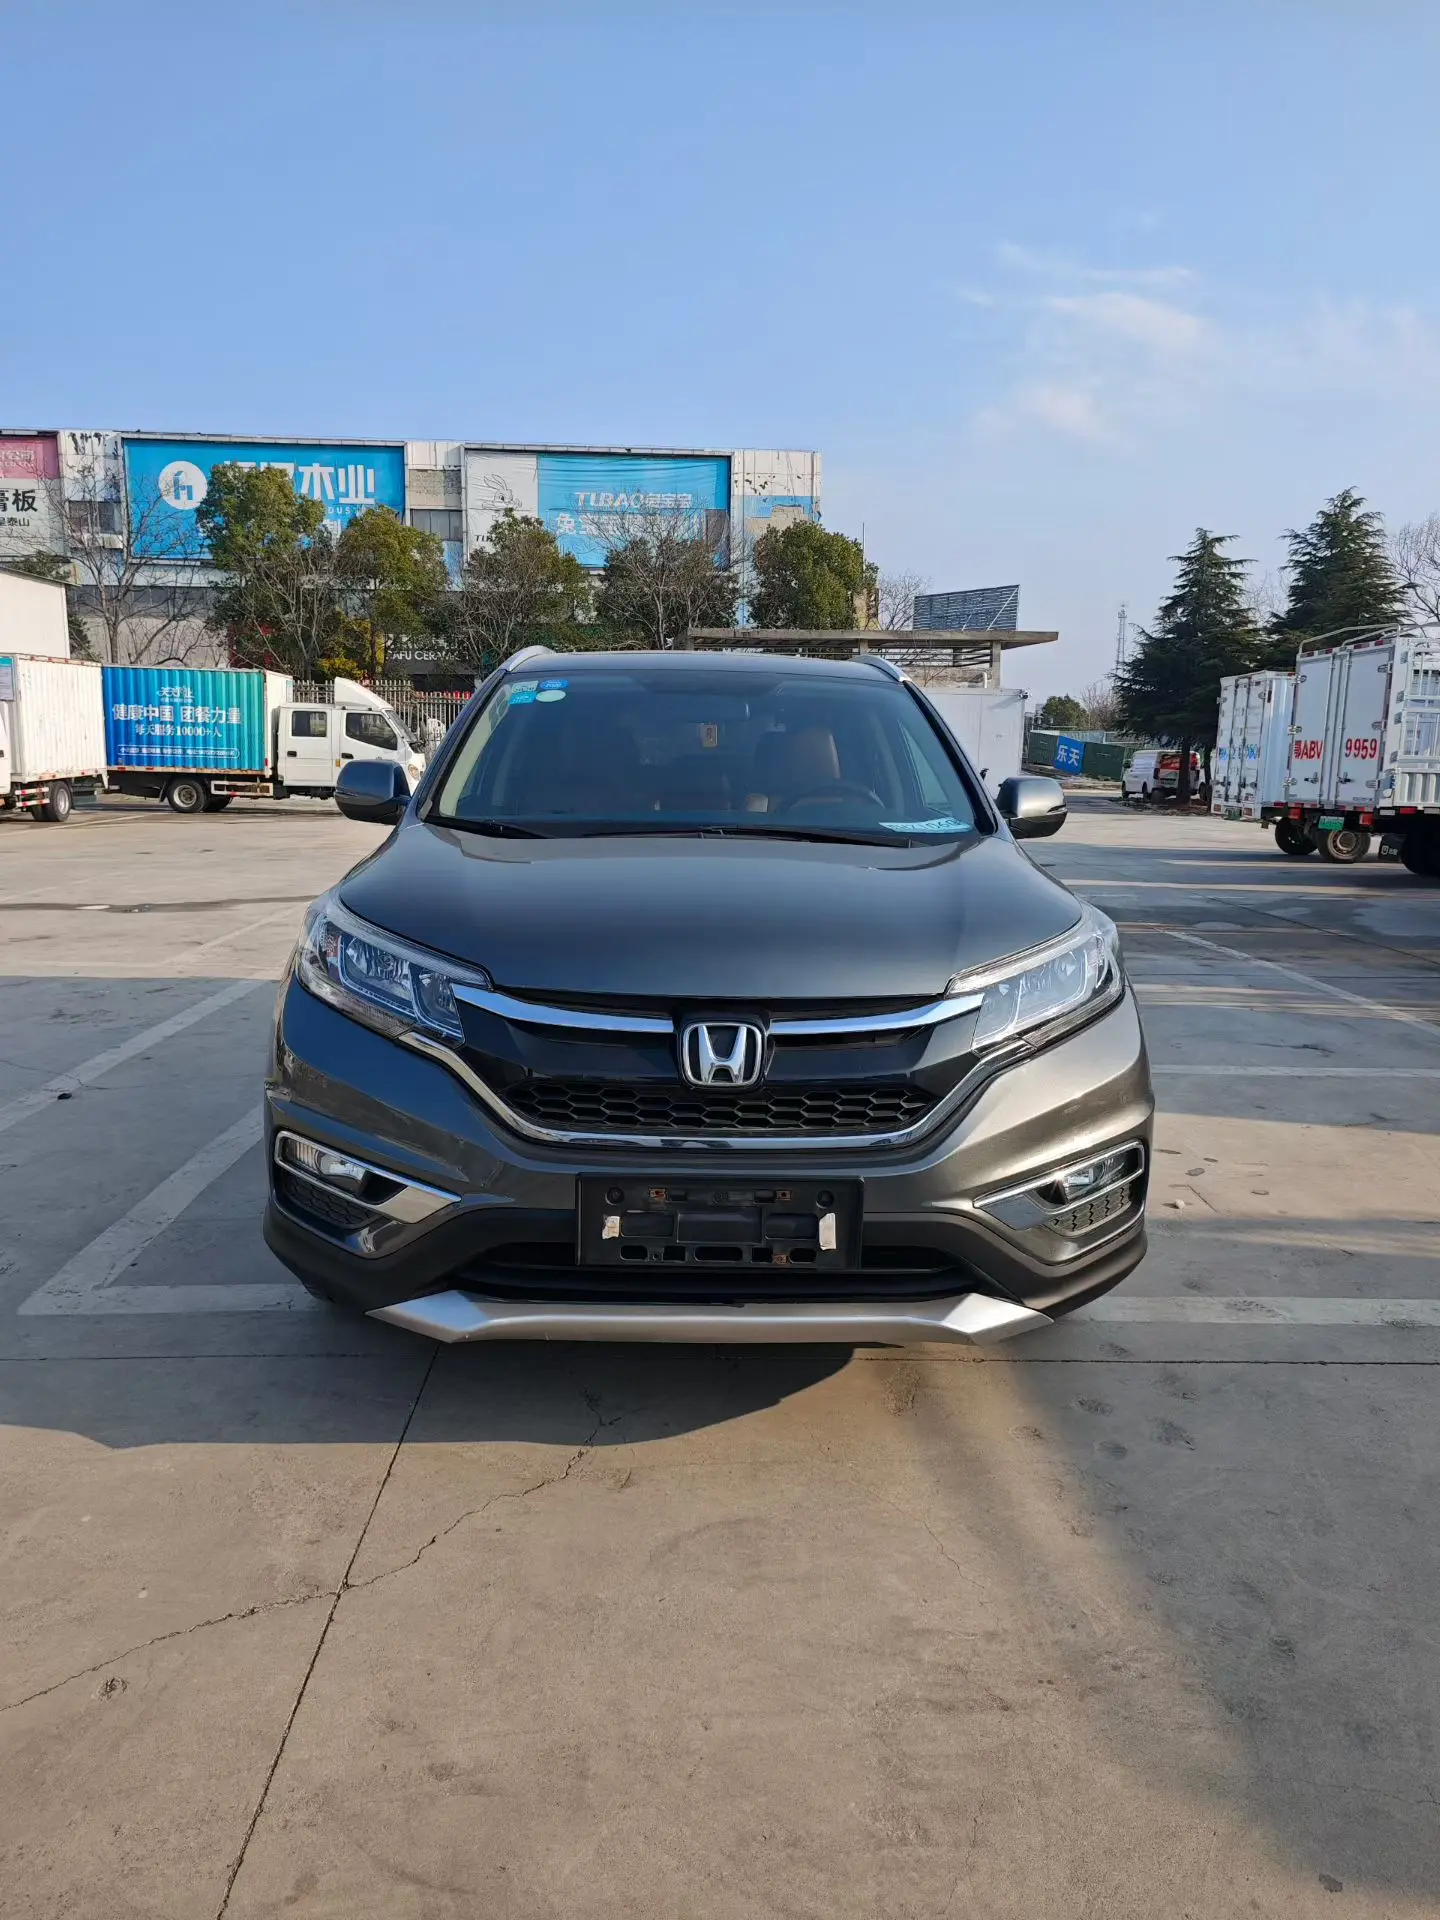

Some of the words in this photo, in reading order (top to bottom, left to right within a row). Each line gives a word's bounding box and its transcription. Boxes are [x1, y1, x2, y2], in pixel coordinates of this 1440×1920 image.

[113, 704, 174, 721] 健康中国
[180, 705, 241, 724] 团餐力量
[1345, 738, 1378, 760] 9959
